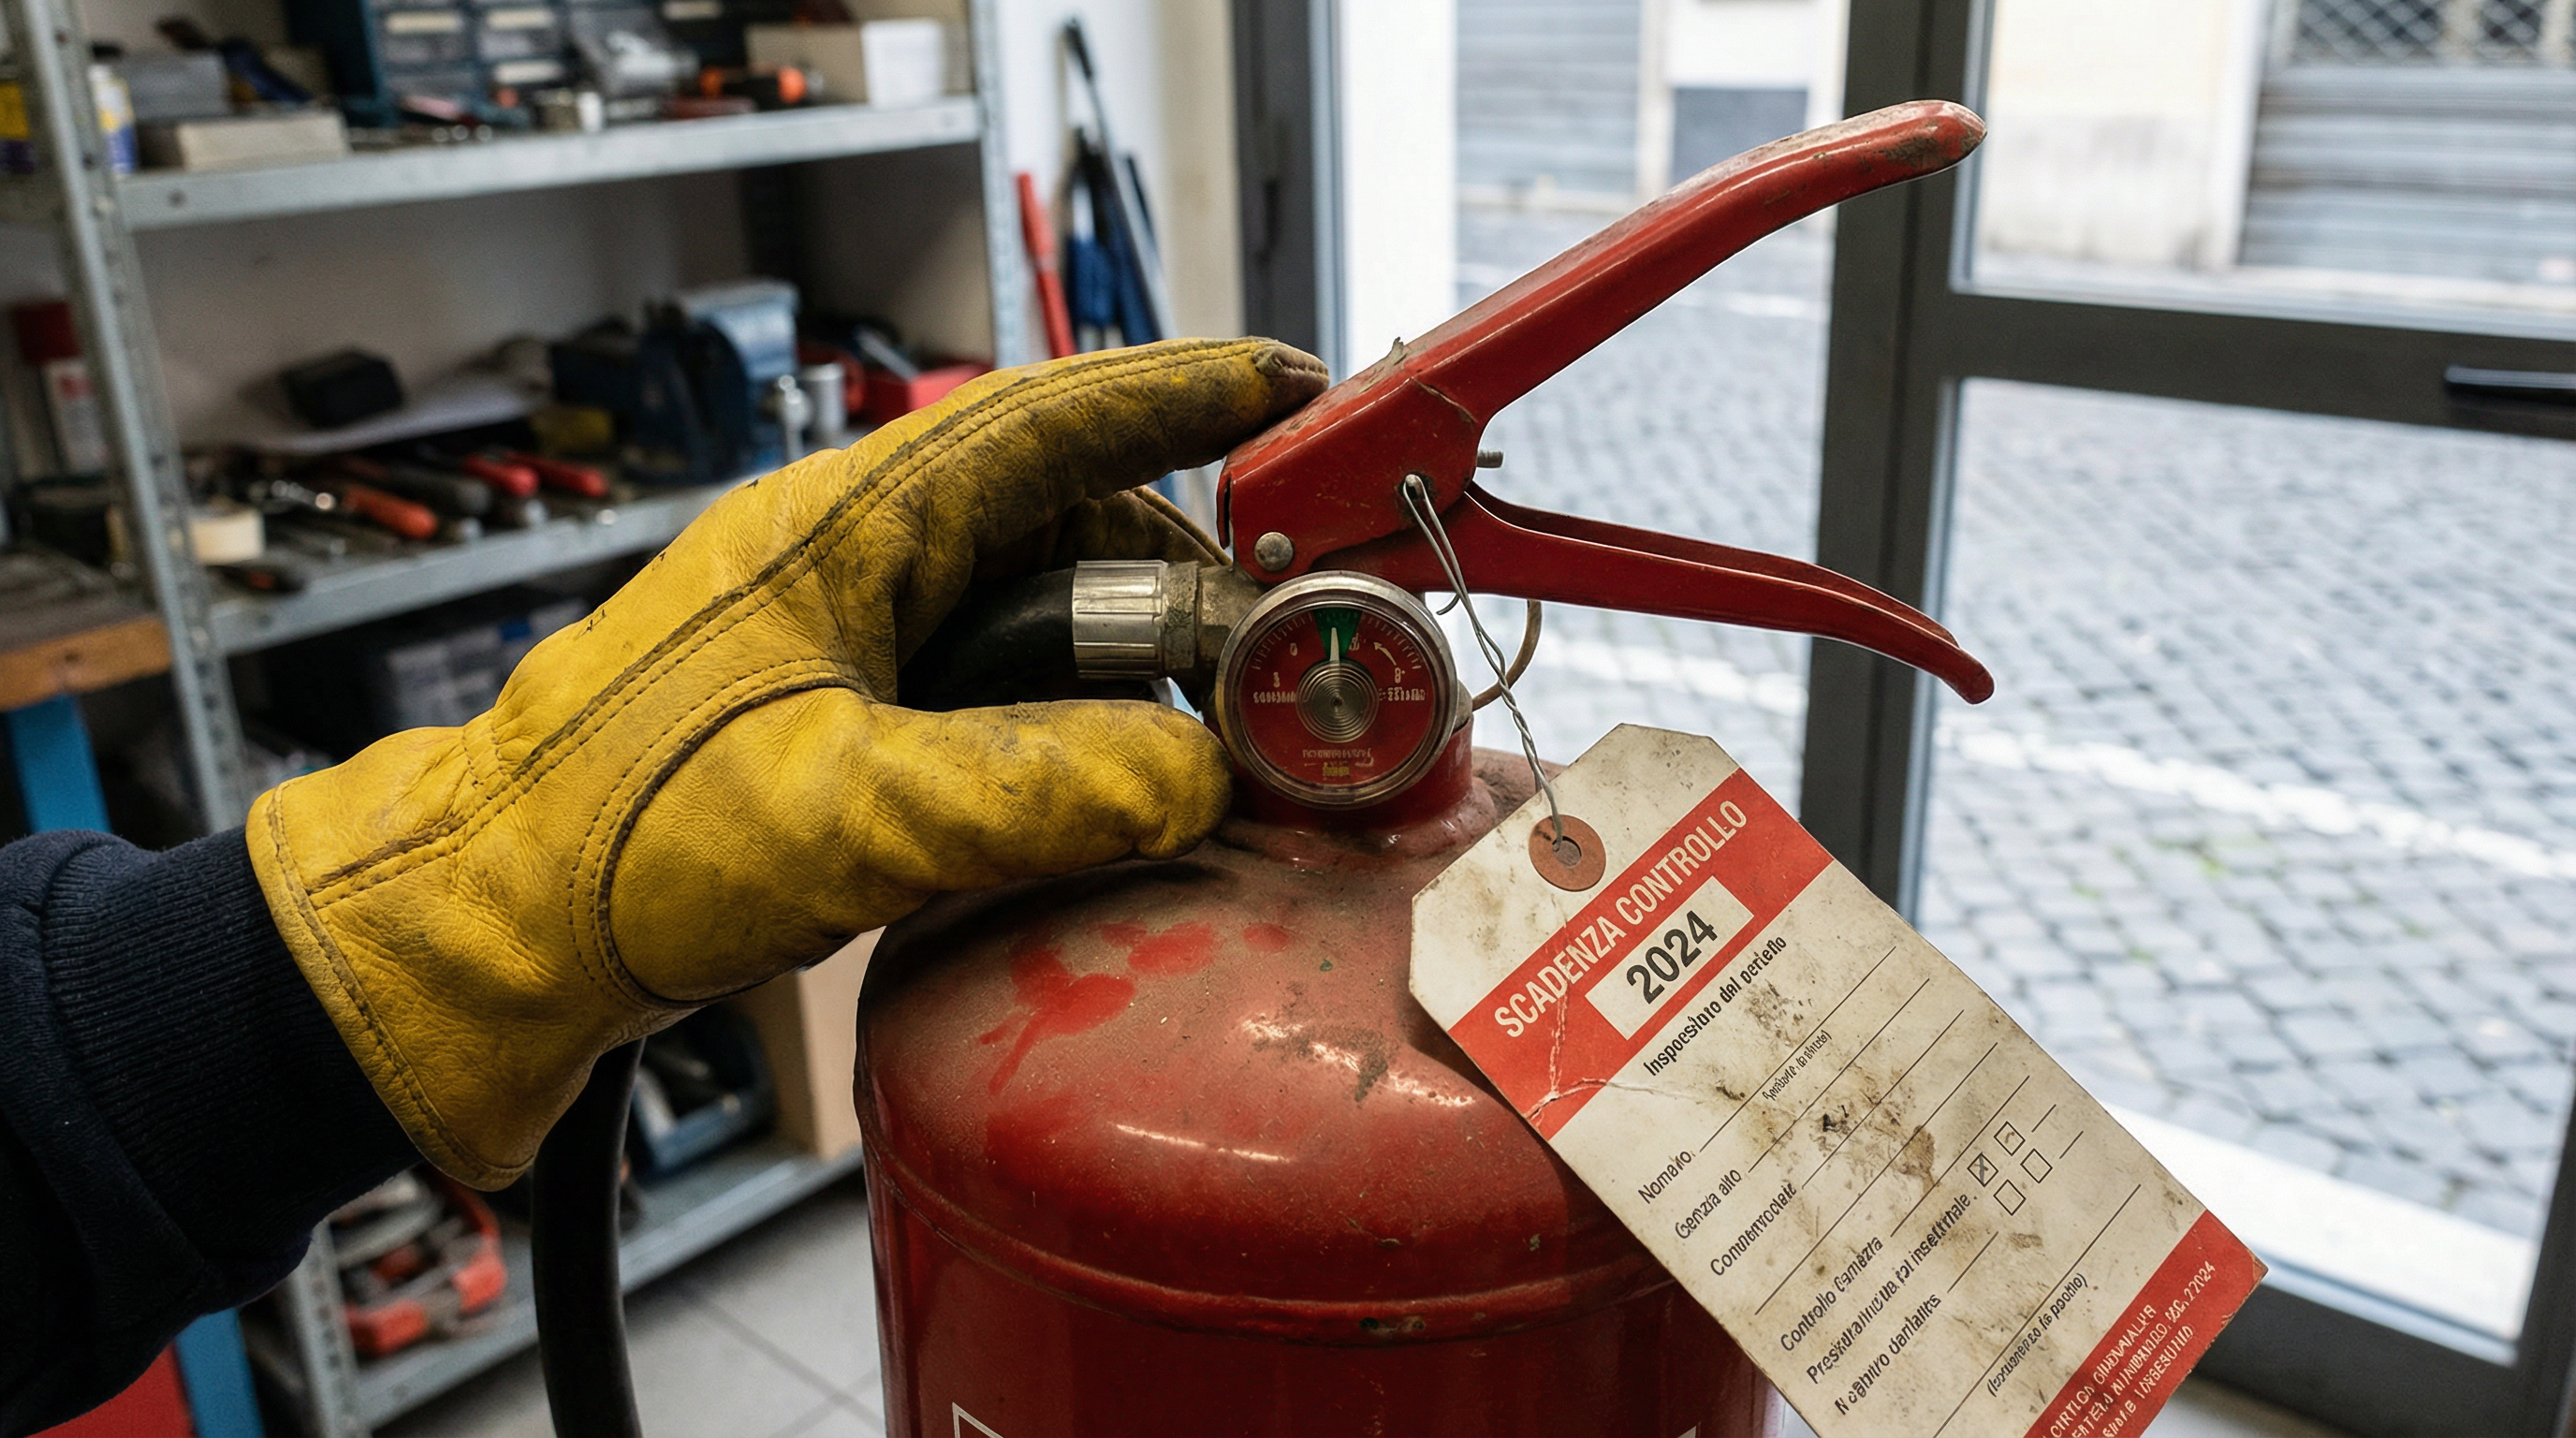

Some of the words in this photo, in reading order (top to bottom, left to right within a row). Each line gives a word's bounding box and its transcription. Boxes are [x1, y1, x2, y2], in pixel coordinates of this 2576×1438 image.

[1495, 917, 1627, 1037] SCADENZA
[1616, 800, 1748, 925] CONTROLLO
[1627, 911, 1719, 1004] 2024
